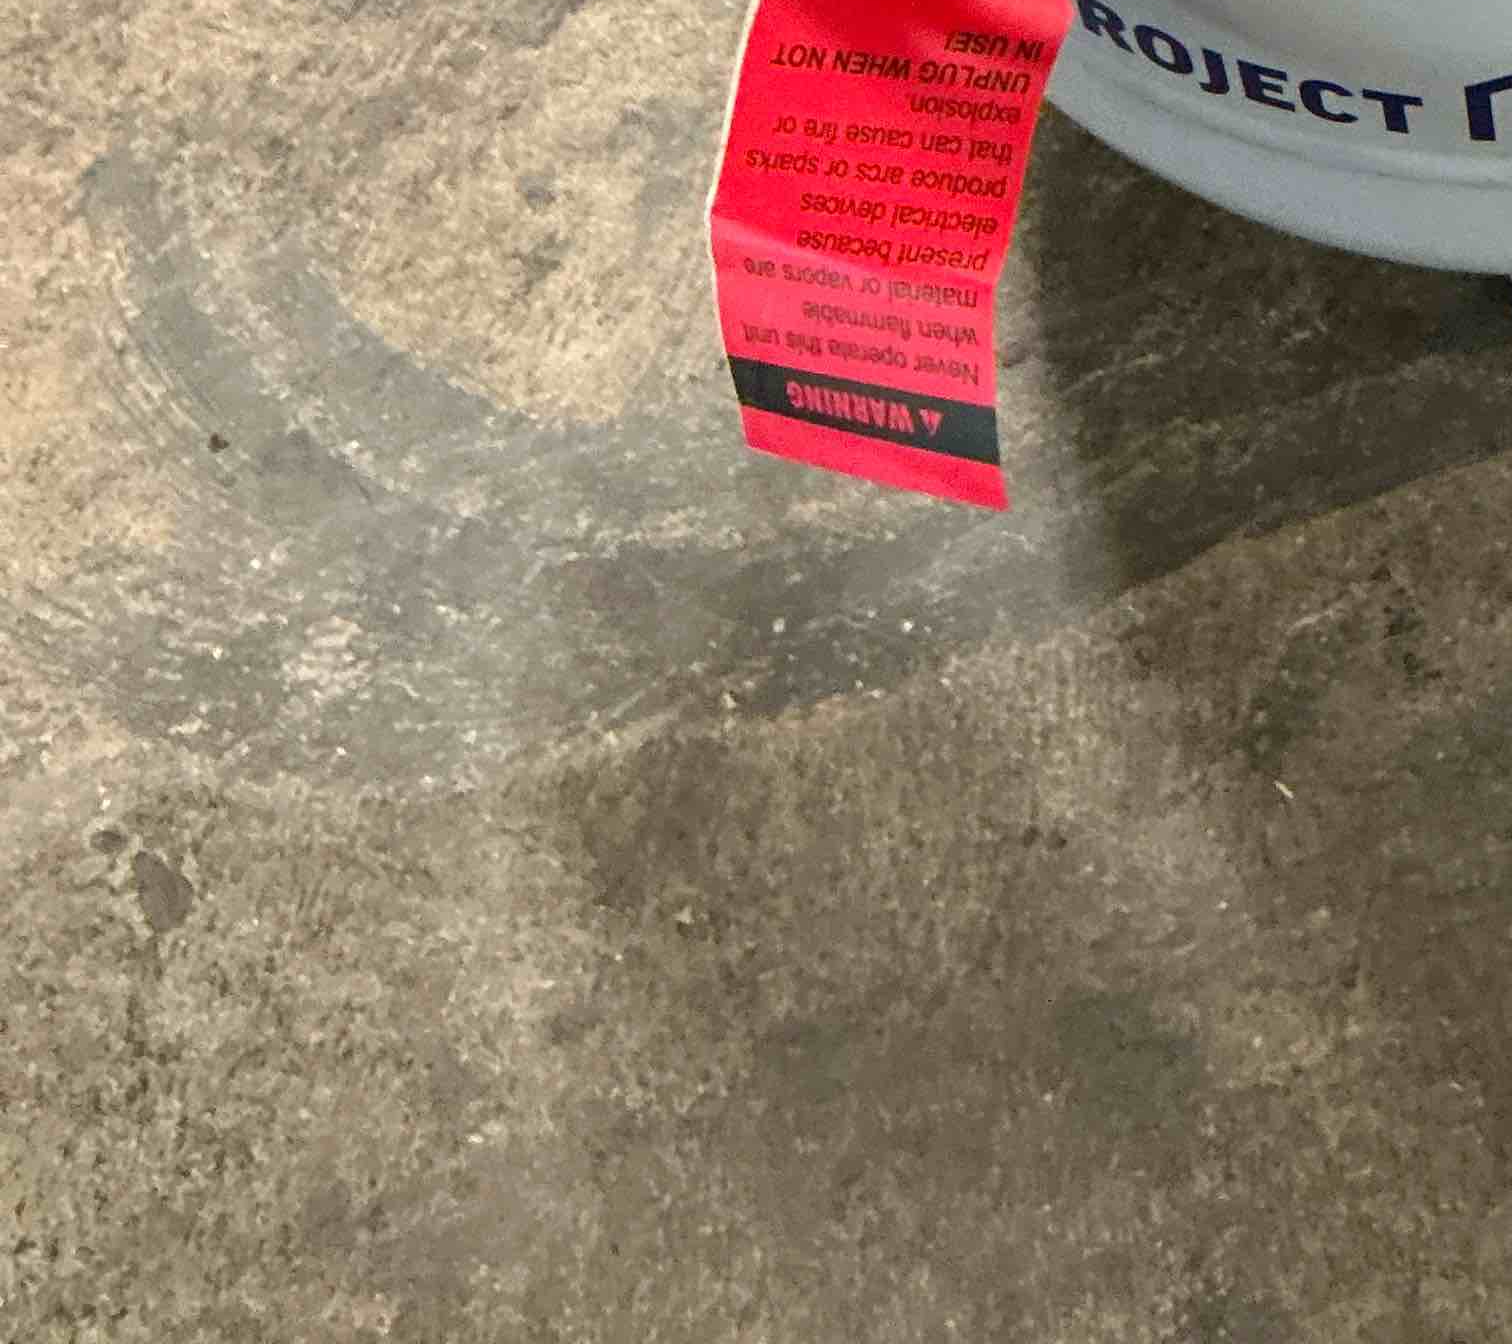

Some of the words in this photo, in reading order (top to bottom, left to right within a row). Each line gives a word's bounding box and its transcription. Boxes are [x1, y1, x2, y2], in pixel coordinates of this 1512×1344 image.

[770, 41, 828, 70] NOT
[943, 29, 1012, 55] USE!
[1015, 37, 1046, 62] IN
[832, 47, 913, 82] WHEN
[919, 59, 1032, 95] UNPLUG
[772, 114, 797, 135] or
[803, 117, 838, 145] fire
[846, 124, 914, 150] cause
[920, 132, 962, 156] can
[967, 139, 1014, 168] that
[745, 148, 820, 175] sparks
[824, 158, 849, 177] or
[855, 162, 905, 184] arcs
[910, 168, 1009, 199] produce
[799, 191, 887, 224] devices
[891, 204, 999, 240] electrical
[796, 229, 892, 266] because
[900, 242, 991, 272] present
[743, 256, 777, 278] are
[782, 263, 853, 292] vapors
[859, 277, 881, 296] or
[886, 281, 979, 311] material
[801, 299, 914, 342] flammable
[915, 318, 980, 347] when
[785, 332, 823, 357] this
[828, 338, 909, 370] operate
[913, 359, 980, 387] Never
[784, 379, 915, 433] WARNING
